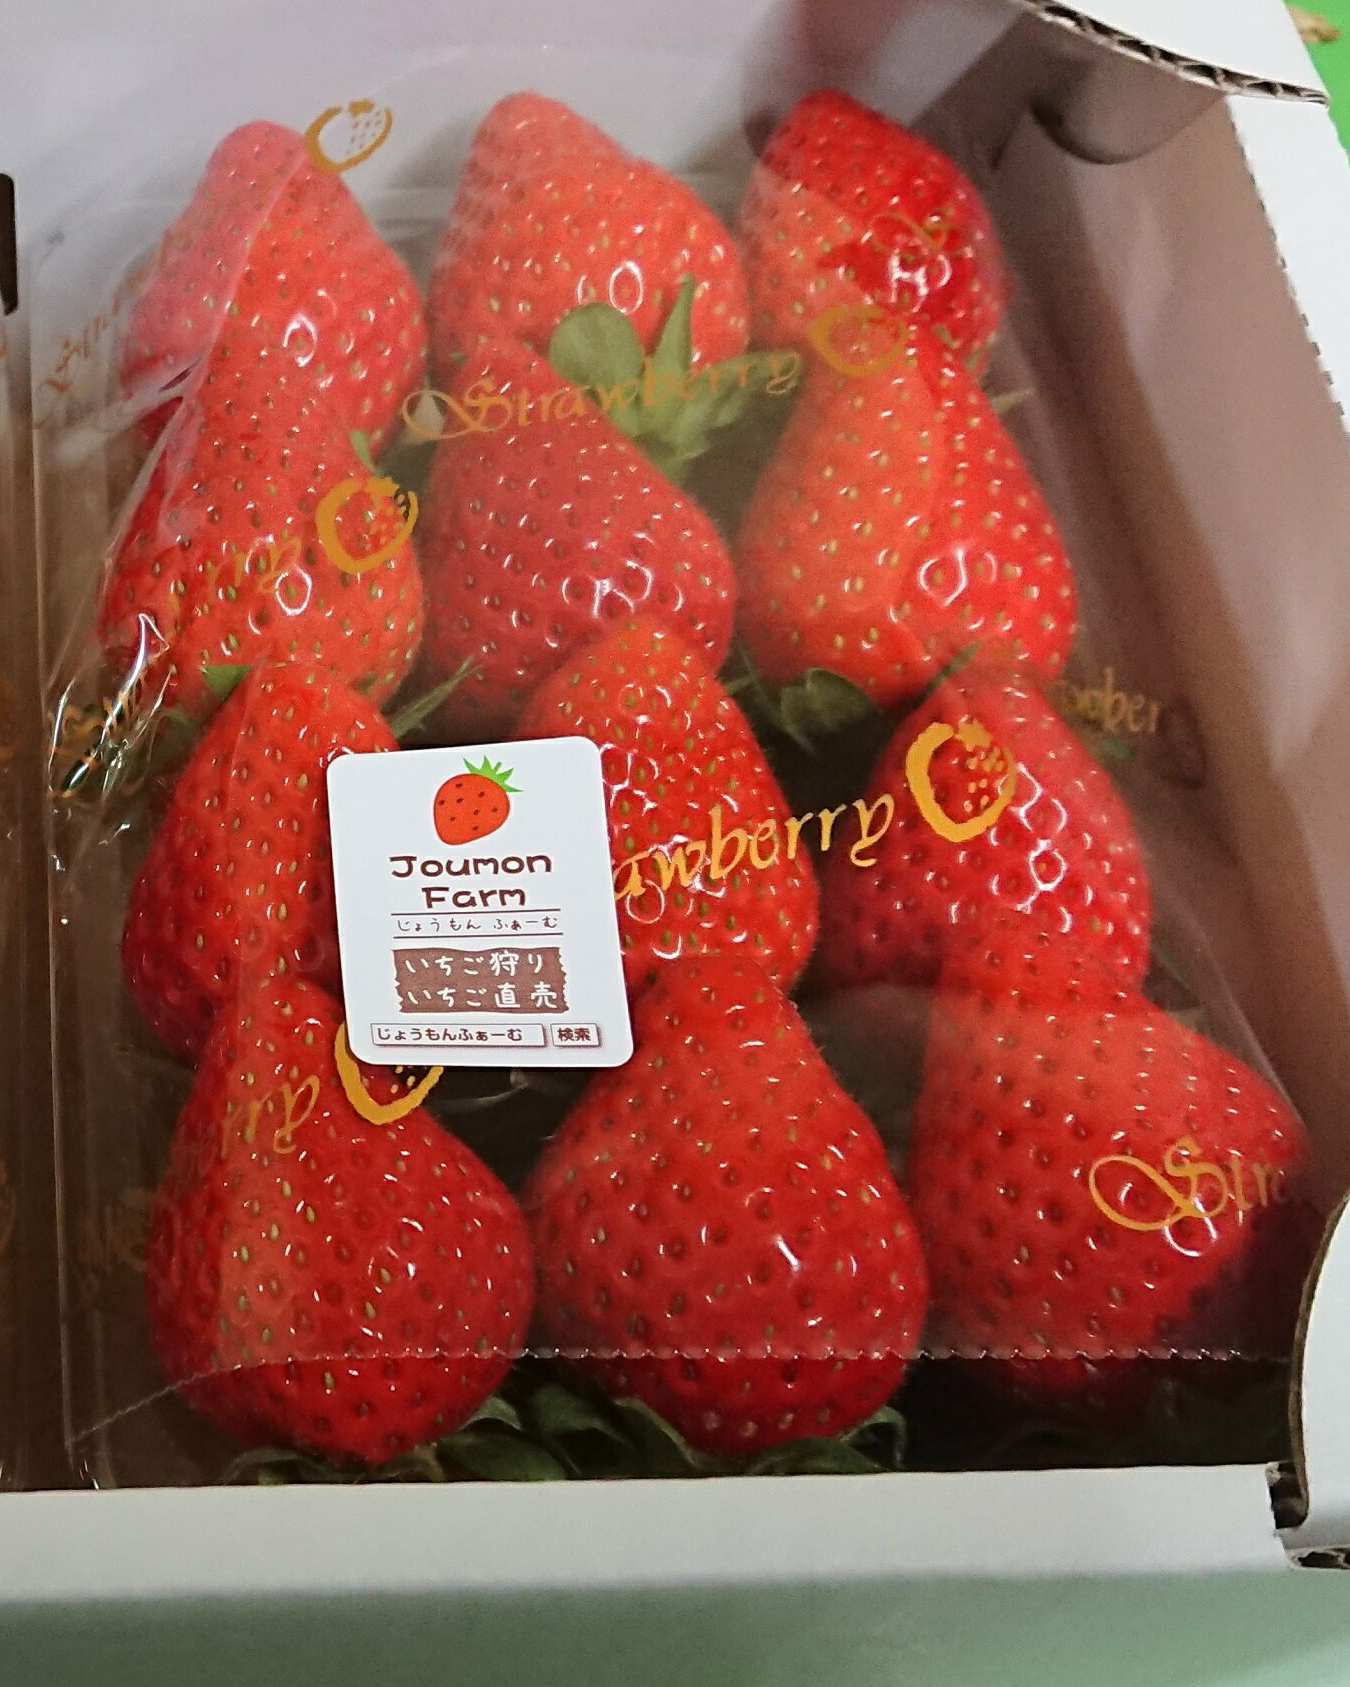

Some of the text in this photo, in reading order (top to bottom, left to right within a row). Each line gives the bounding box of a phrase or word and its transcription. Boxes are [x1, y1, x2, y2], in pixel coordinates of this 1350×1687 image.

[389, 854, 553, 879] Joumon
[421, 886, 527, 910] Farm
[405, 949, 544, 977] いちご狩り
[408, 981, 558, 1010] いちご直売
[376, 1026, 592, 1044] じょうもんふぁーむ 検索
